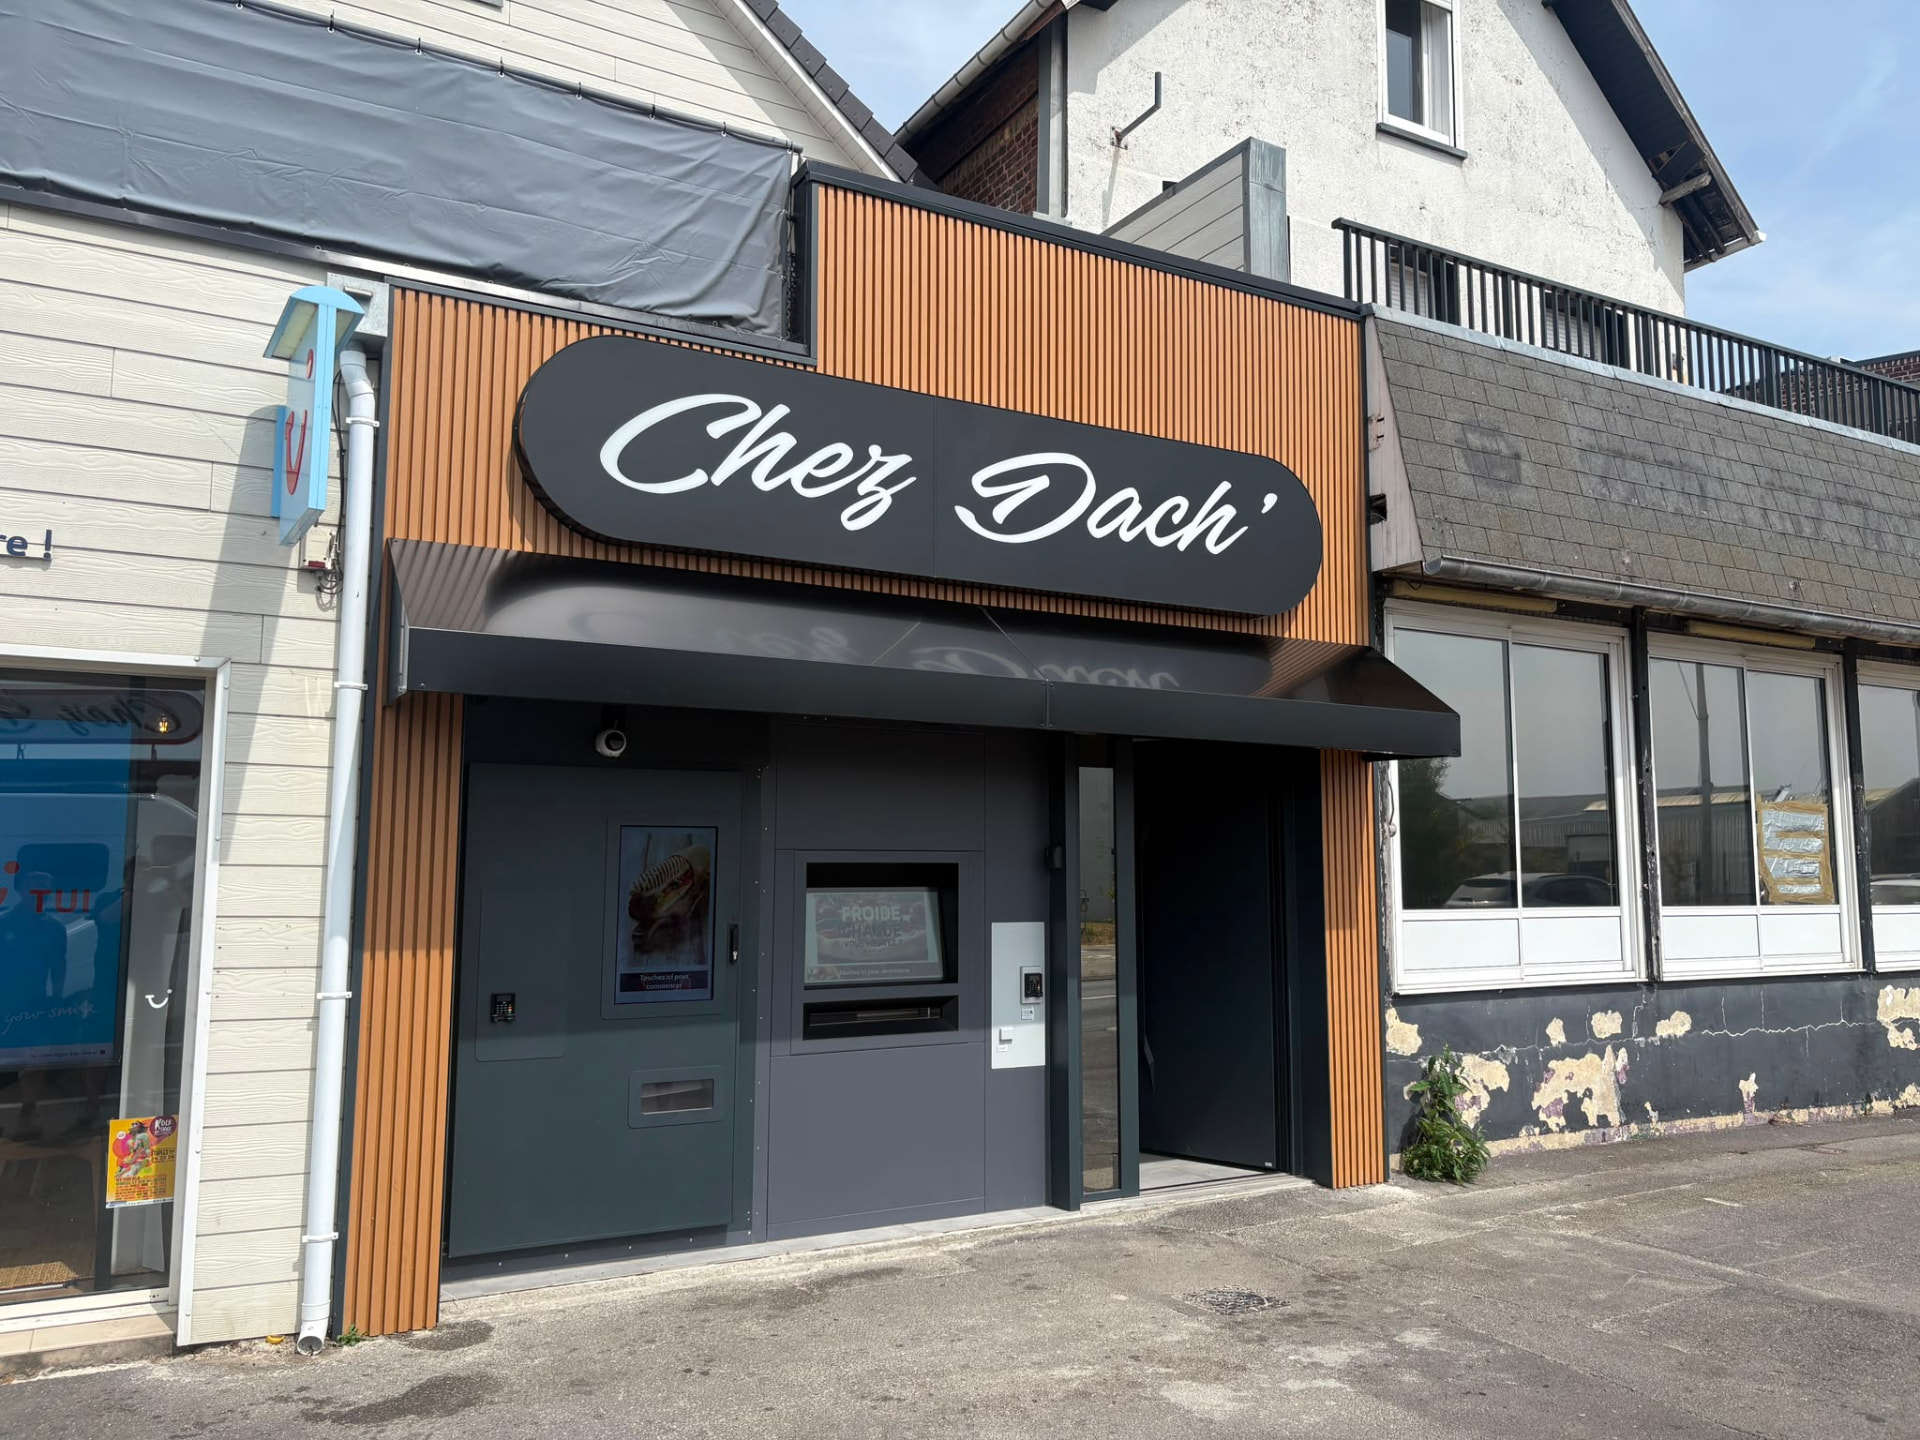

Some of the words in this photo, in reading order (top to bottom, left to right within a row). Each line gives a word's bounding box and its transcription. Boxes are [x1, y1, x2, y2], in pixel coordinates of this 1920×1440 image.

[599, 393, 917, 532] Chez
[954, 451, 1279, 555] Dach'
[29, 888, 91, 913] TUI
[841, 905, 901, 922] FROIDE
